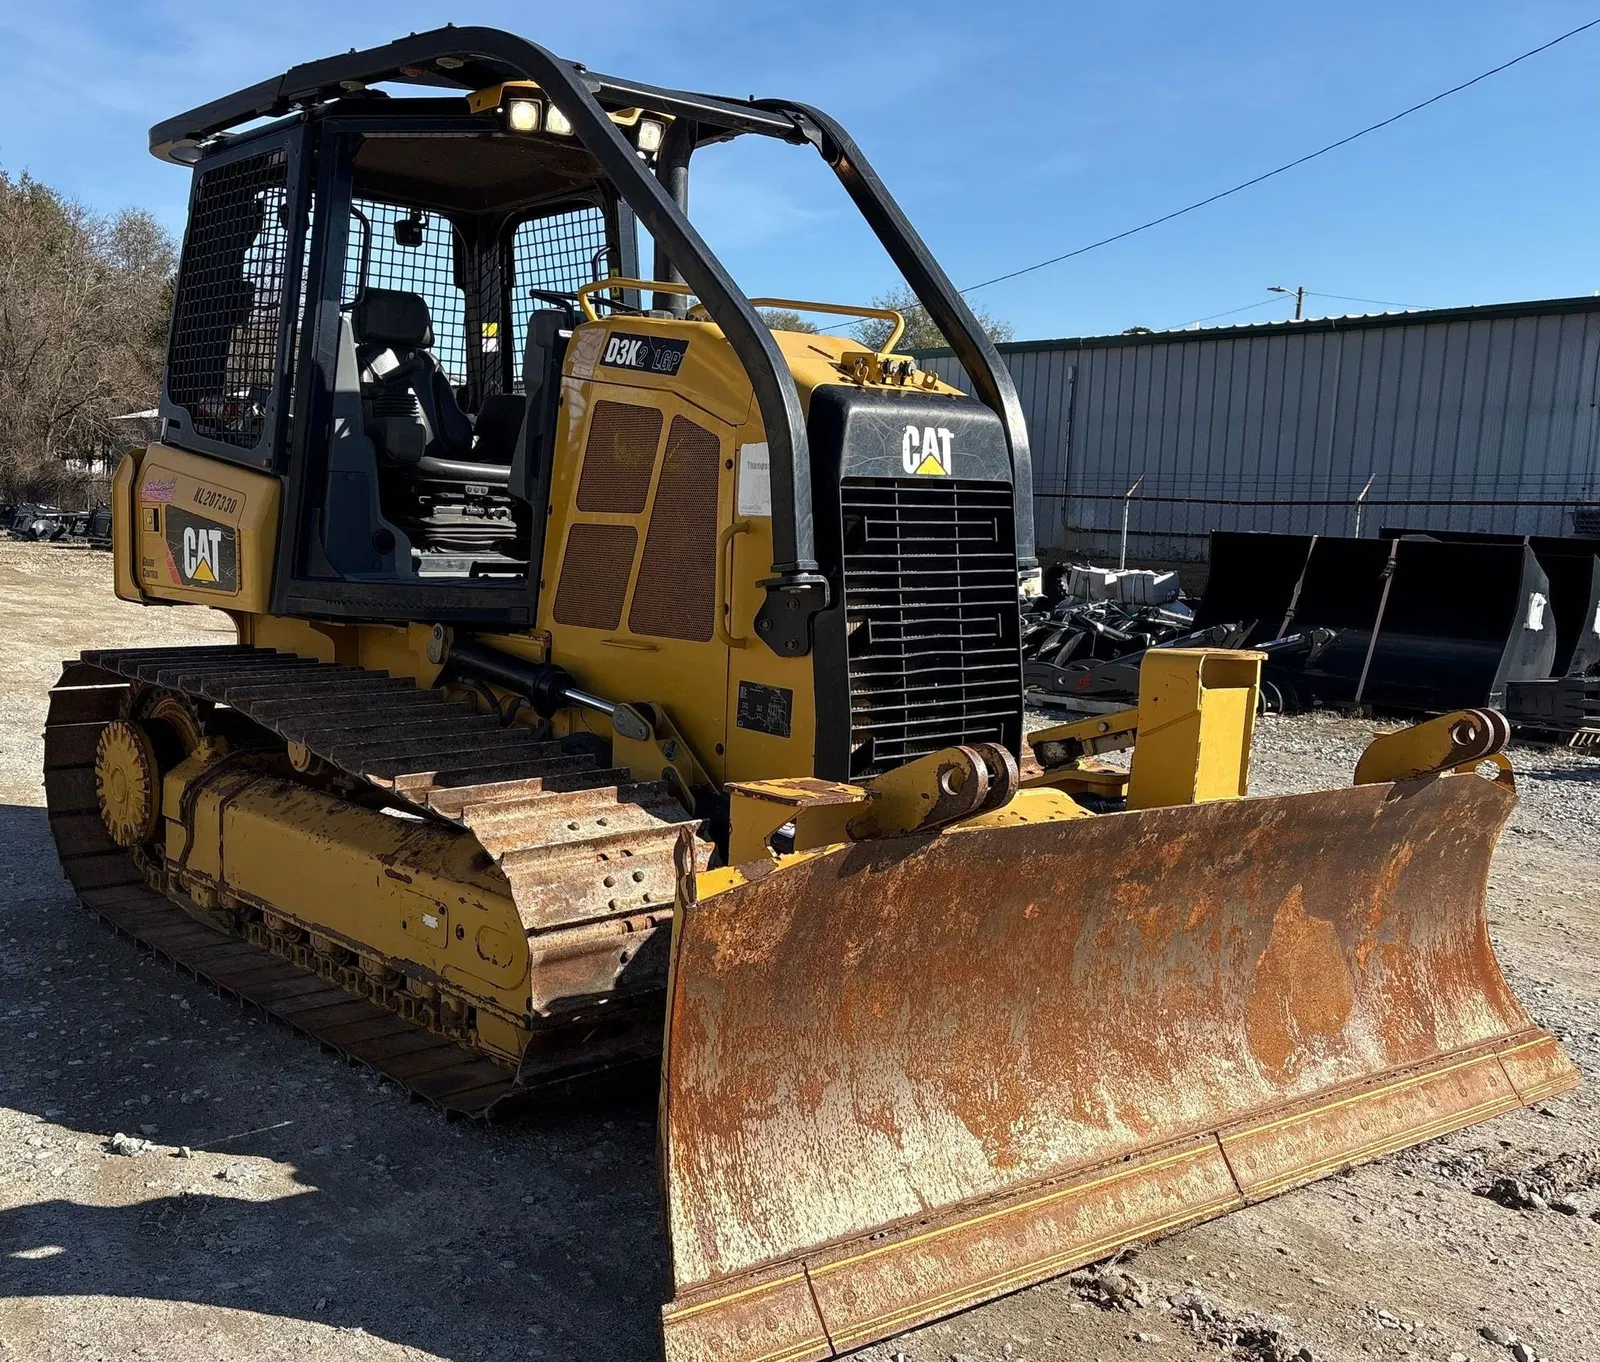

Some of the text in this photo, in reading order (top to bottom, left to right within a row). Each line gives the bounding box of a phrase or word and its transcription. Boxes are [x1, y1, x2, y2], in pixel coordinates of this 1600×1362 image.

[651, 349, 681, 371] LGP
[902, 425, 955, 476] CAT
[747, 461, 771, 470] Thomps
[193, 487, 238, 514] KL207330
[183, 526, 222, 582] CAT
